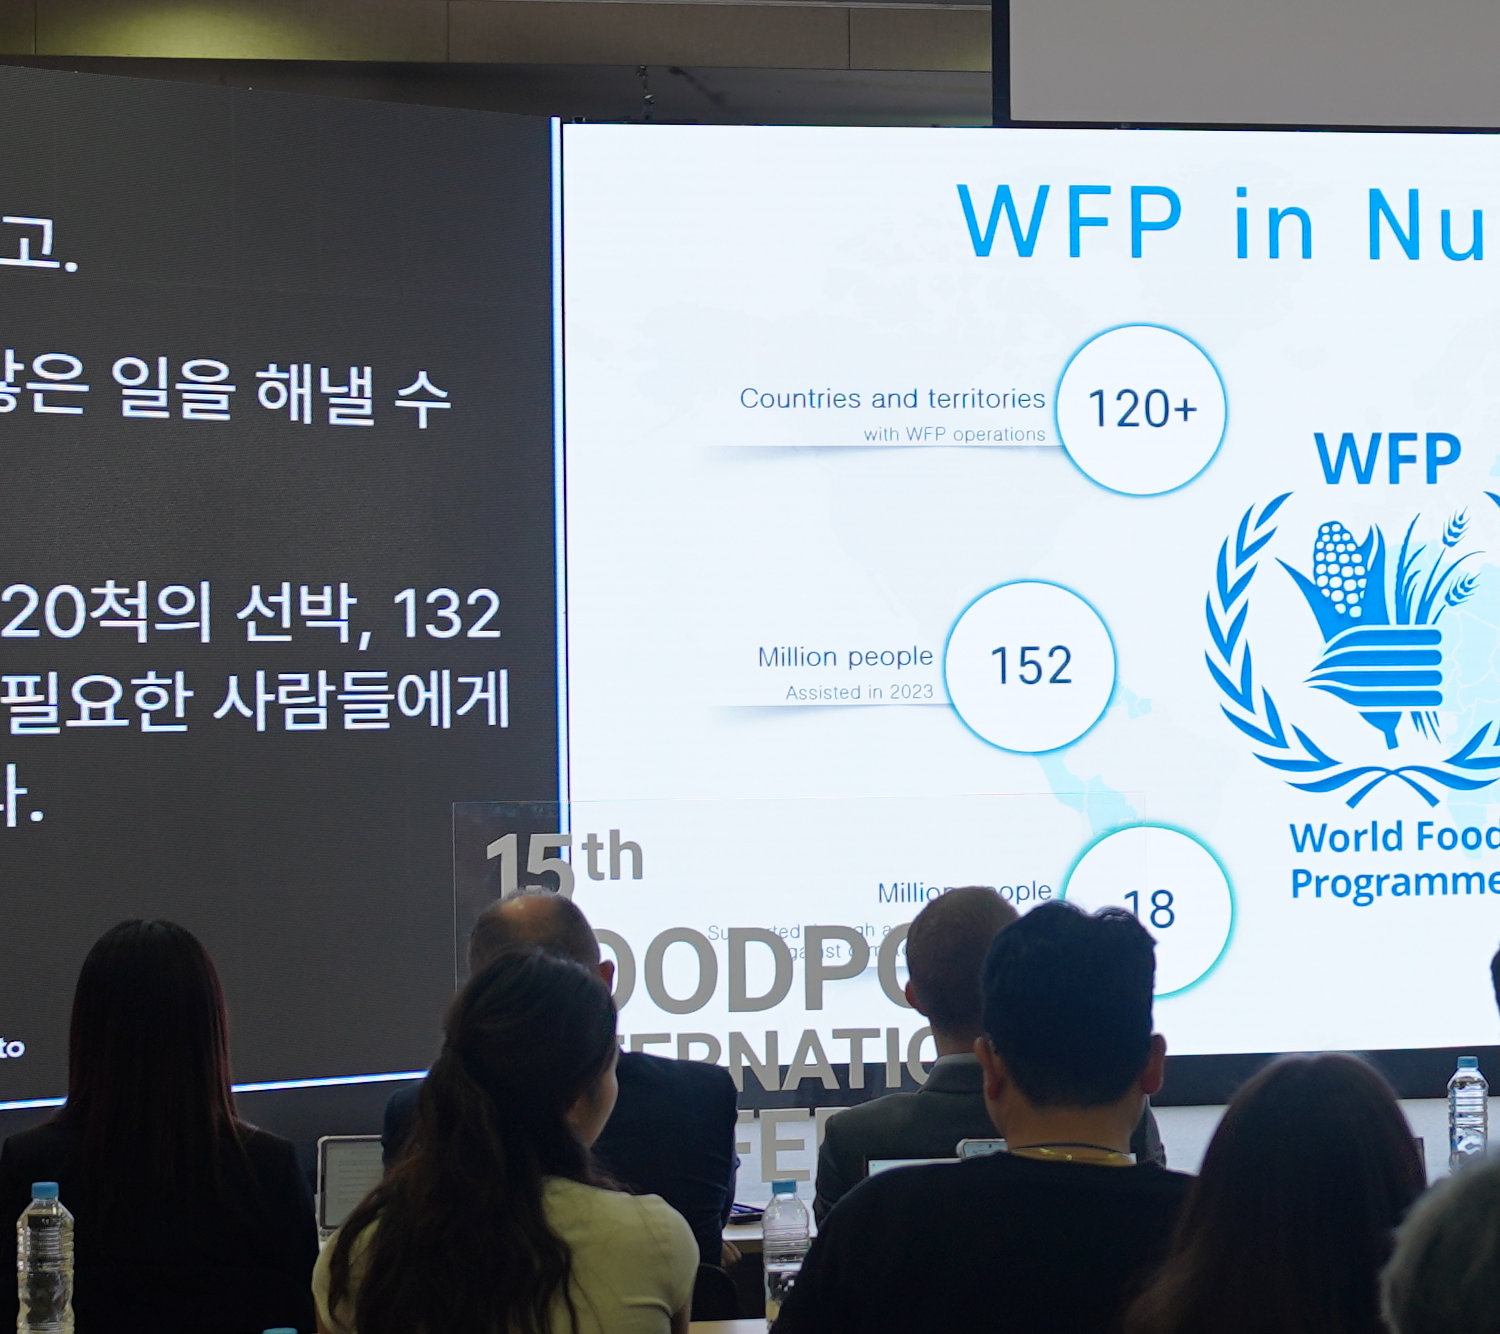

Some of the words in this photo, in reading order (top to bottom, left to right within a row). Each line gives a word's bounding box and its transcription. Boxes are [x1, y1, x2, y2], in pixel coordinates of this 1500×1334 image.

[956, 184, 1182, 258] WFP
[1236, 186, 1312, 259] in
[112, 357, 236, 420] 일을
[256, 364, 374, 426] 해낼
[395, 371, 451, 429] 수
[740, 388, 861, 409] Countries
[872, 388, 917, 408] and
[928, 388, 1045, 409] territories
[1090, 389, 1197, 428] 120+
[864, 427, 899, 441] with
[906, 426, 946, 441] WFP
[954, 428, 1045, 443] operations
[1313, 432, 1461, 484] WFP
[1, 580, 210, 643] 20척의
[237, 582, 371, 650] 선박,
[394, 588, 500, 638] 132
[759, 646, 836, 667] Million
[849, 645, 933, 670] people
[992, 645, 1072, 685] 152
[0, 671, 194, 734] 필요한
[214, 669, 508, 731] 사람들에게
[786, 685, 860, 700] Assisted
[869, 683, 882, 699] in
[890, 684, 933, 699] 2023
[1289, 820, 1402, 853] World
[990, 880, 1052, 905] ople
[1124, 889, 1175, 929] 18
